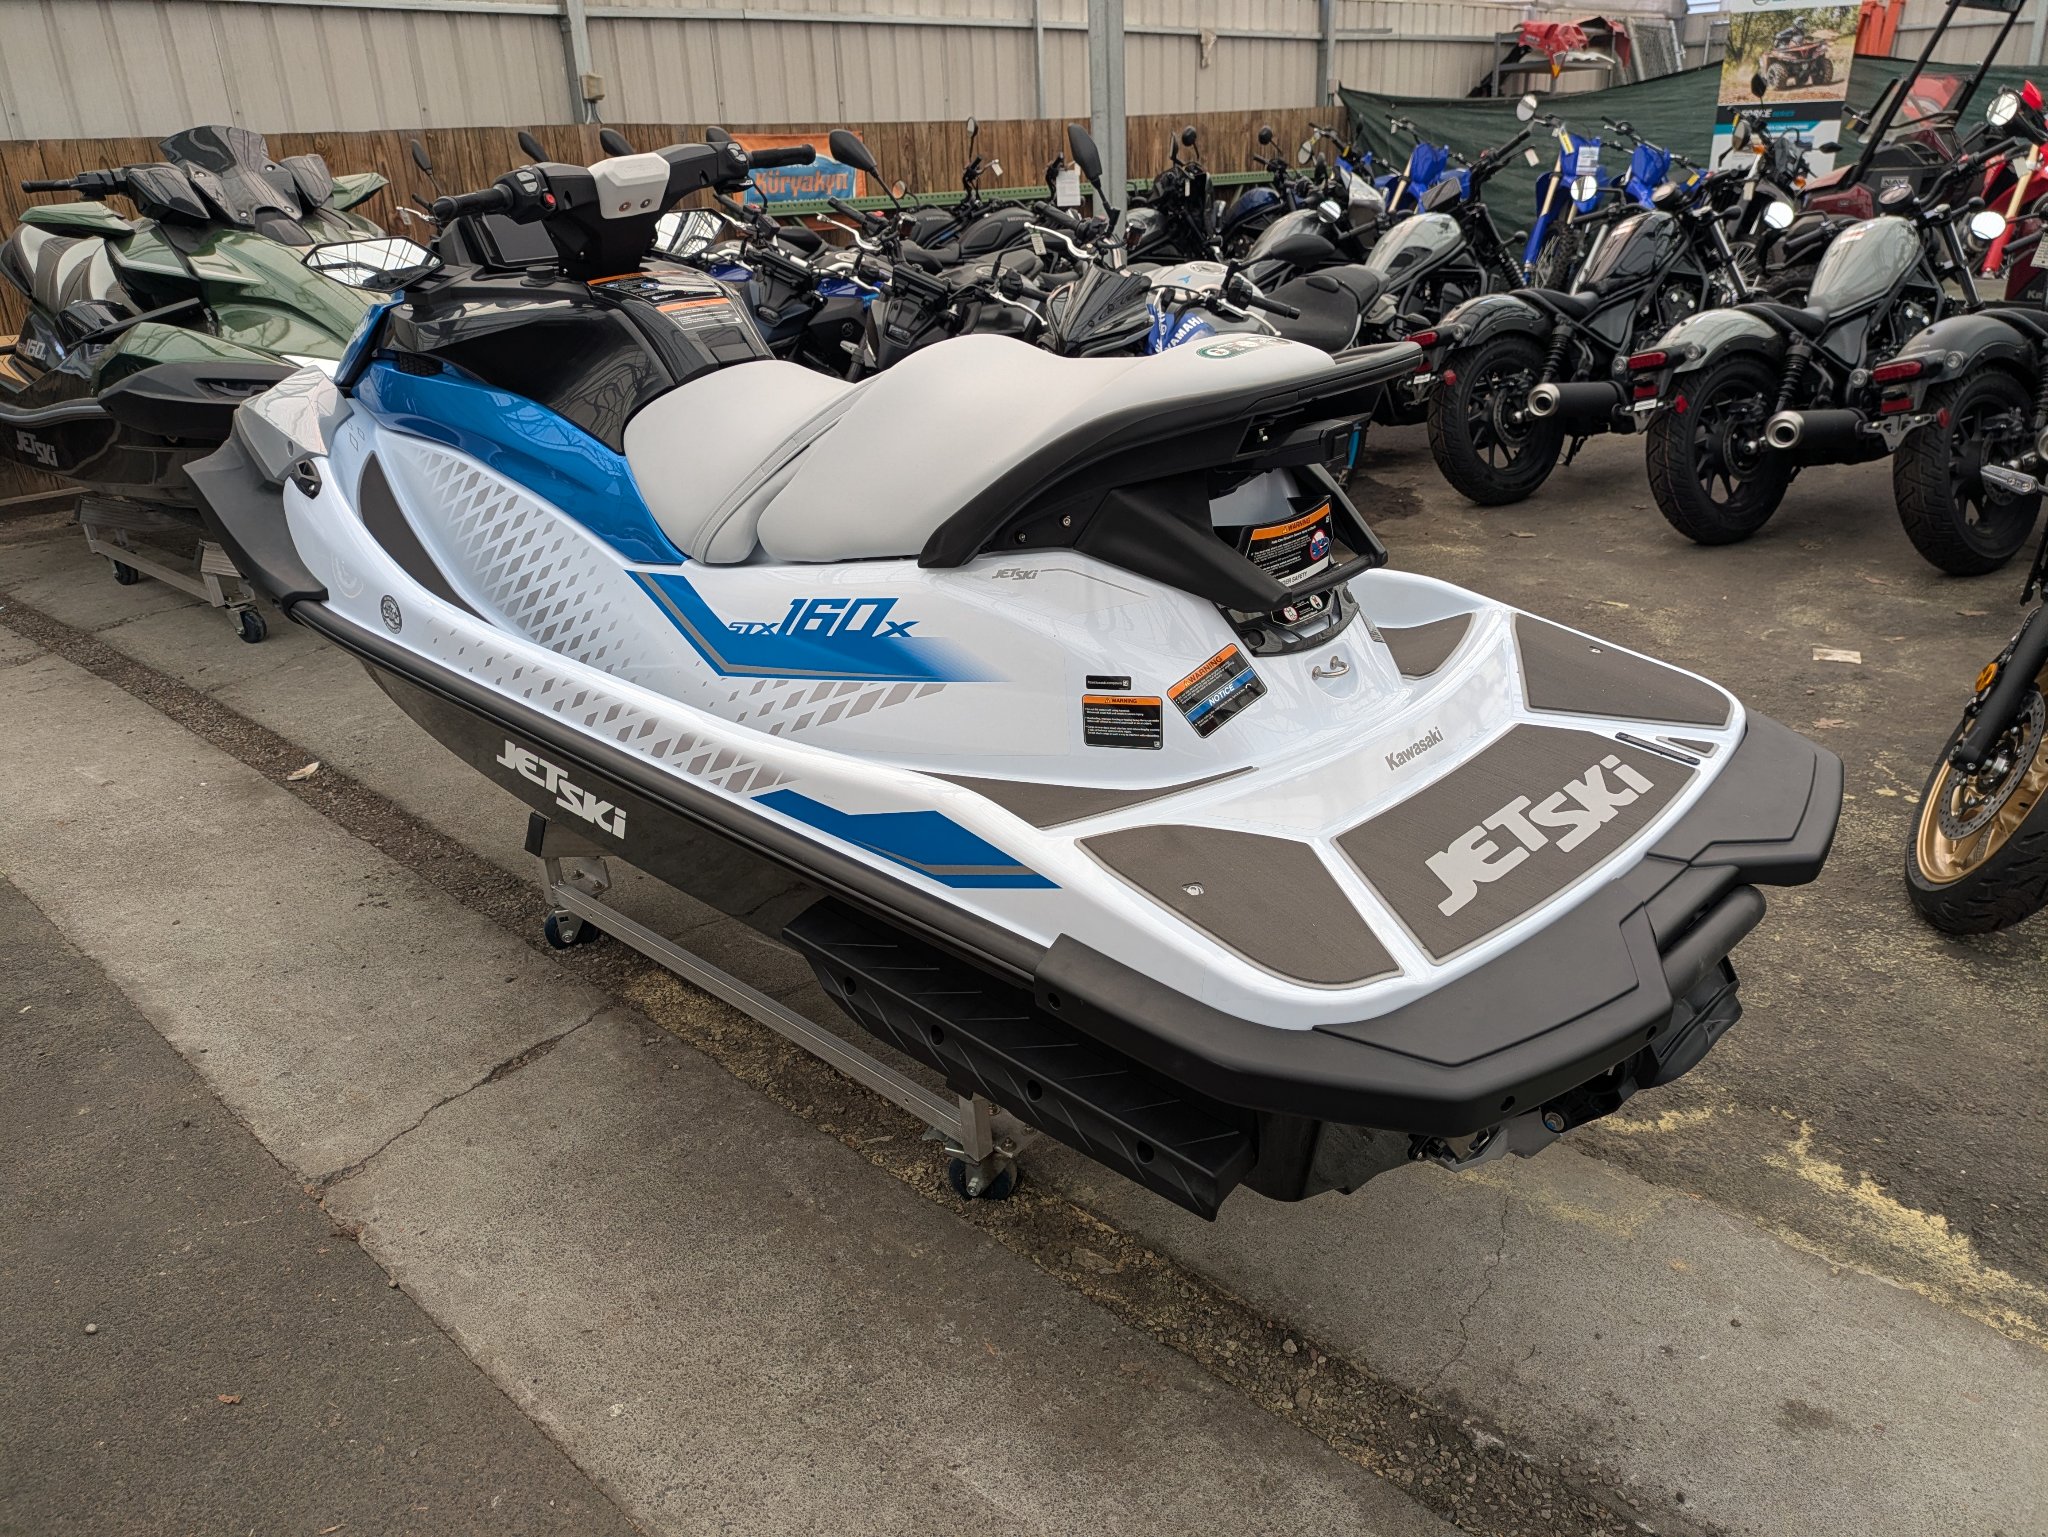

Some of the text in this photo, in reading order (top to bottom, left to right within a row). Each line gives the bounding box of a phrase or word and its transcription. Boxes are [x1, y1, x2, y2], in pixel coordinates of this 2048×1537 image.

[1187, 655, 1223, 685] WARNING
[1208, 683, 1235, 707] NOTICE
[1384, 726, 1444, 772] Kawasaki
